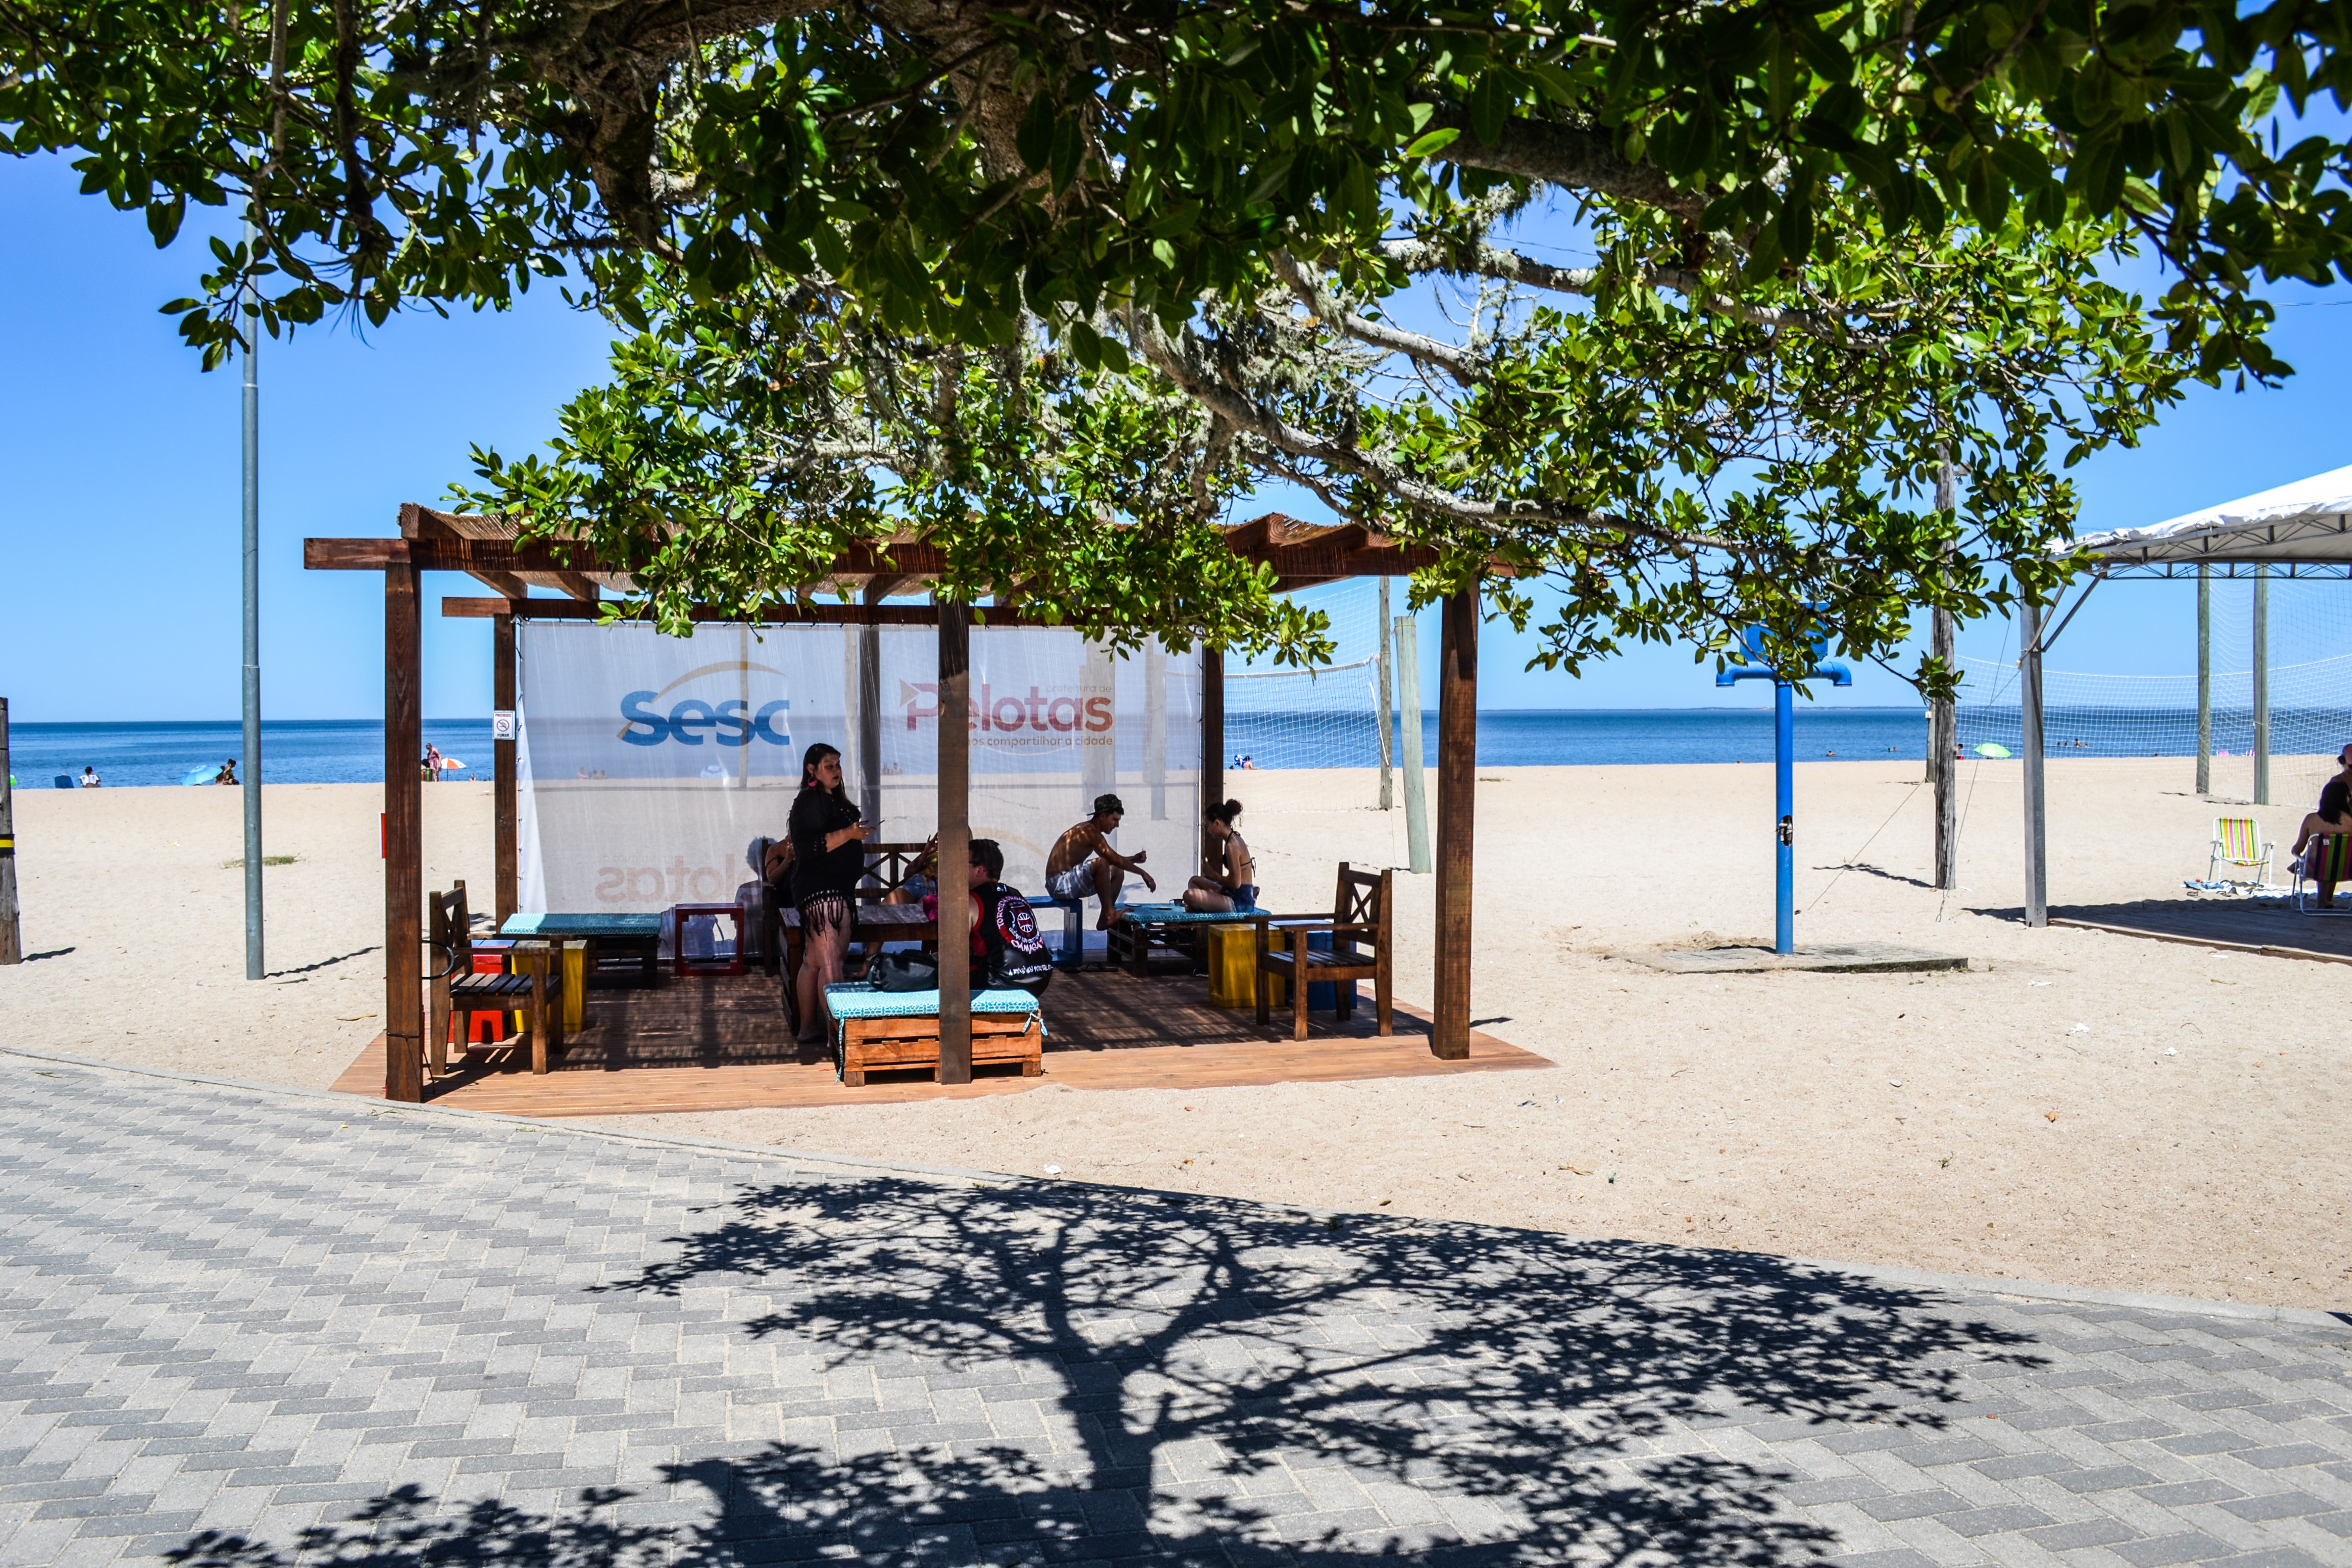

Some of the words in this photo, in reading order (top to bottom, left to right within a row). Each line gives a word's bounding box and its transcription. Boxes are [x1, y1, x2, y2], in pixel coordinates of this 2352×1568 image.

[1046, 684, 1097, 694] prefeitura
[1099, 684, 1112, 693] de
[620, 691, 790, 747] Sesc
[987, 736, 1062, 748] compartilhar
[1075, 736, 1113, 746] cidade
